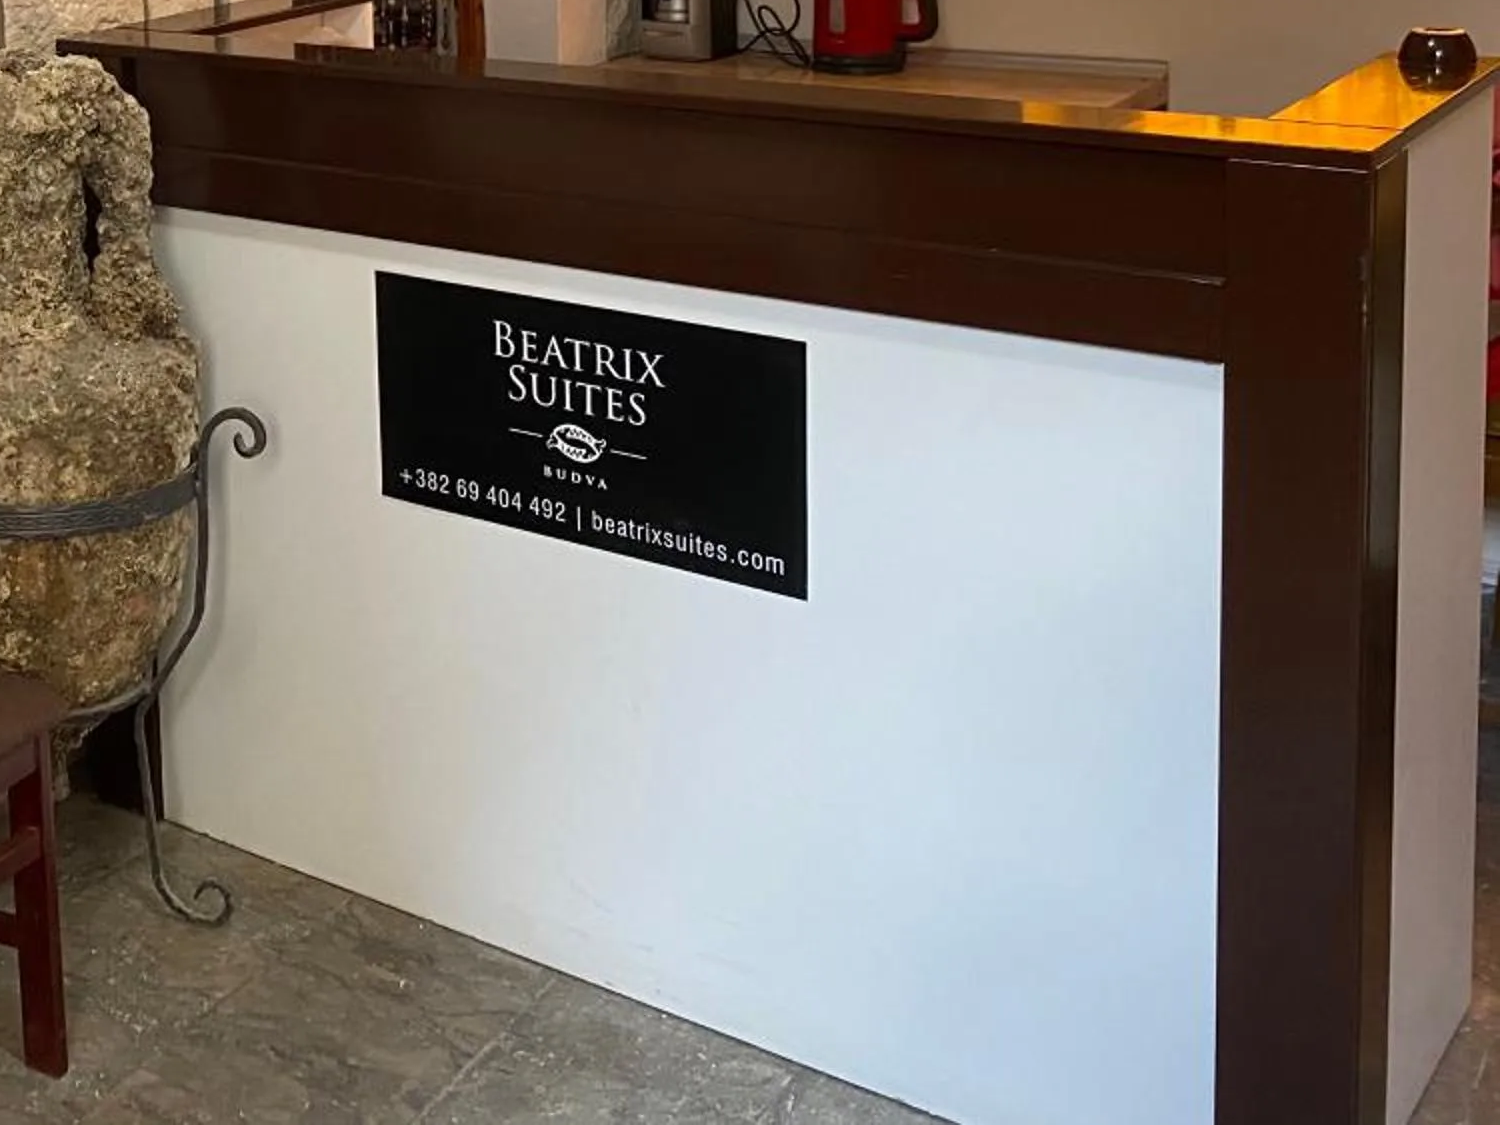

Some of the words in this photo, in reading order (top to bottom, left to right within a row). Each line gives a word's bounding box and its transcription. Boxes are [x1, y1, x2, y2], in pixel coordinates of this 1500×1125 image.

[493, 320, 666, 388] BEATRIX
[508, 365, 646, 426] SUITES
[543, 464, 608, 490] BUDVA
[400, 468, 450, 494] +382
[456, 479, 480, 501] 69
[486, 489, 522, 513] 404
[529, 498, 567, 523] 492
[591, 510, 786, 576] beatrixsuites.com
